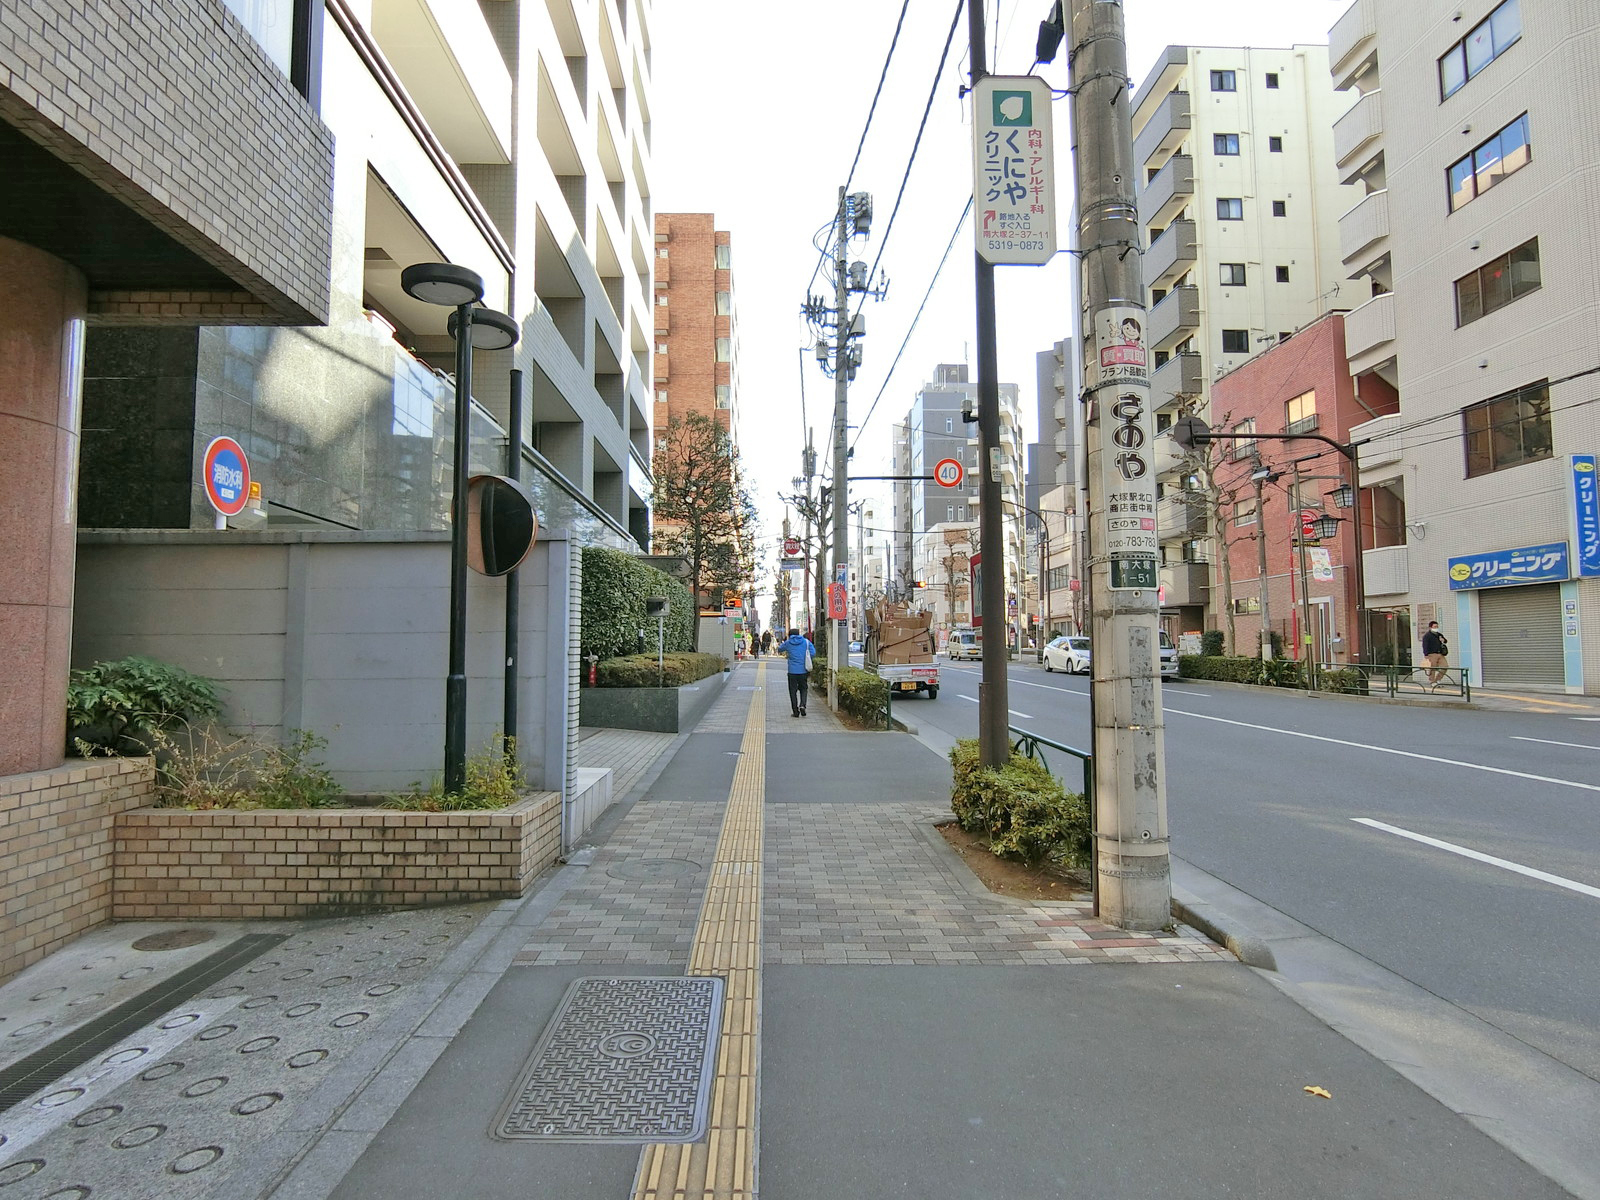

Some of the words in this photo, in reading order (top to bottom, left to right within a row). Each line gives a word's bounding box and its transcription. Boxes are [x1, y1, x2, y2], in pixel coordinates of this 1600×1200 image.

[984, 130, 1002, 202] クリニック
[1003, 129, 1027, 206] くにや
[1028, 129, 1045, 214] 内科・アレルギー科
[999, 213, 1031, 221] 路地入る
[999, 222, 1031, 230] すぐ入口
[983, 231, 1049, 239] 南大塚2-37-11
[988, 240, 1044, 250] 5319-0873
[1111, 391, 1147, 482] さのや
[941, 466, 956, 479] 40
[1109, 492, 1153, 503] 大塚駅北口
[1580, 477, 1600, 558] クリーニング
[1111, 520, 1138, 529] さのや
[1108, 536, 1156, 548] 0120-783-783
[1118, 560, 1152, 570] 南大塚
[1471, 552, 1562, 578] クリーニング
